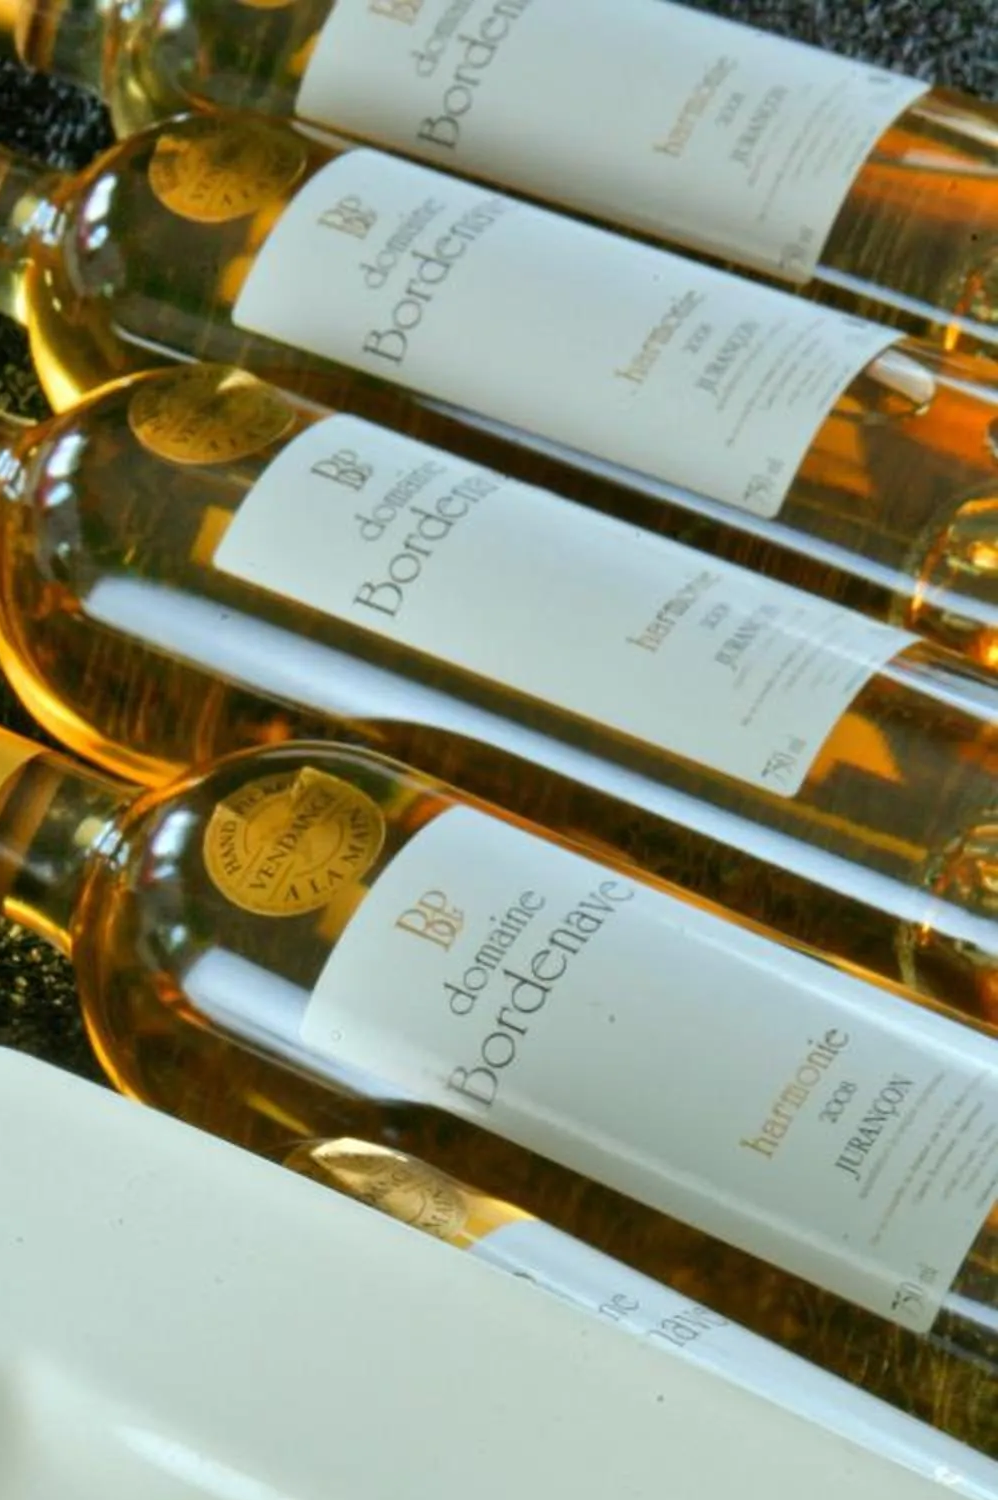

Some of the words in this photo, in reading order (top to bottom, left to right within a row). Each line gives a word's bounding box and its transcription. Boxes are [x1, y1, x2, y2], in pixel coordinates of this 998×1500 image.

[442, 889, 547, 1016] domaine
[446, 880, 634, 1108] Bordenave
[739, 1027, 850, 1160] harmonie
[834, 1071, 914, 1182] JURANÇON
